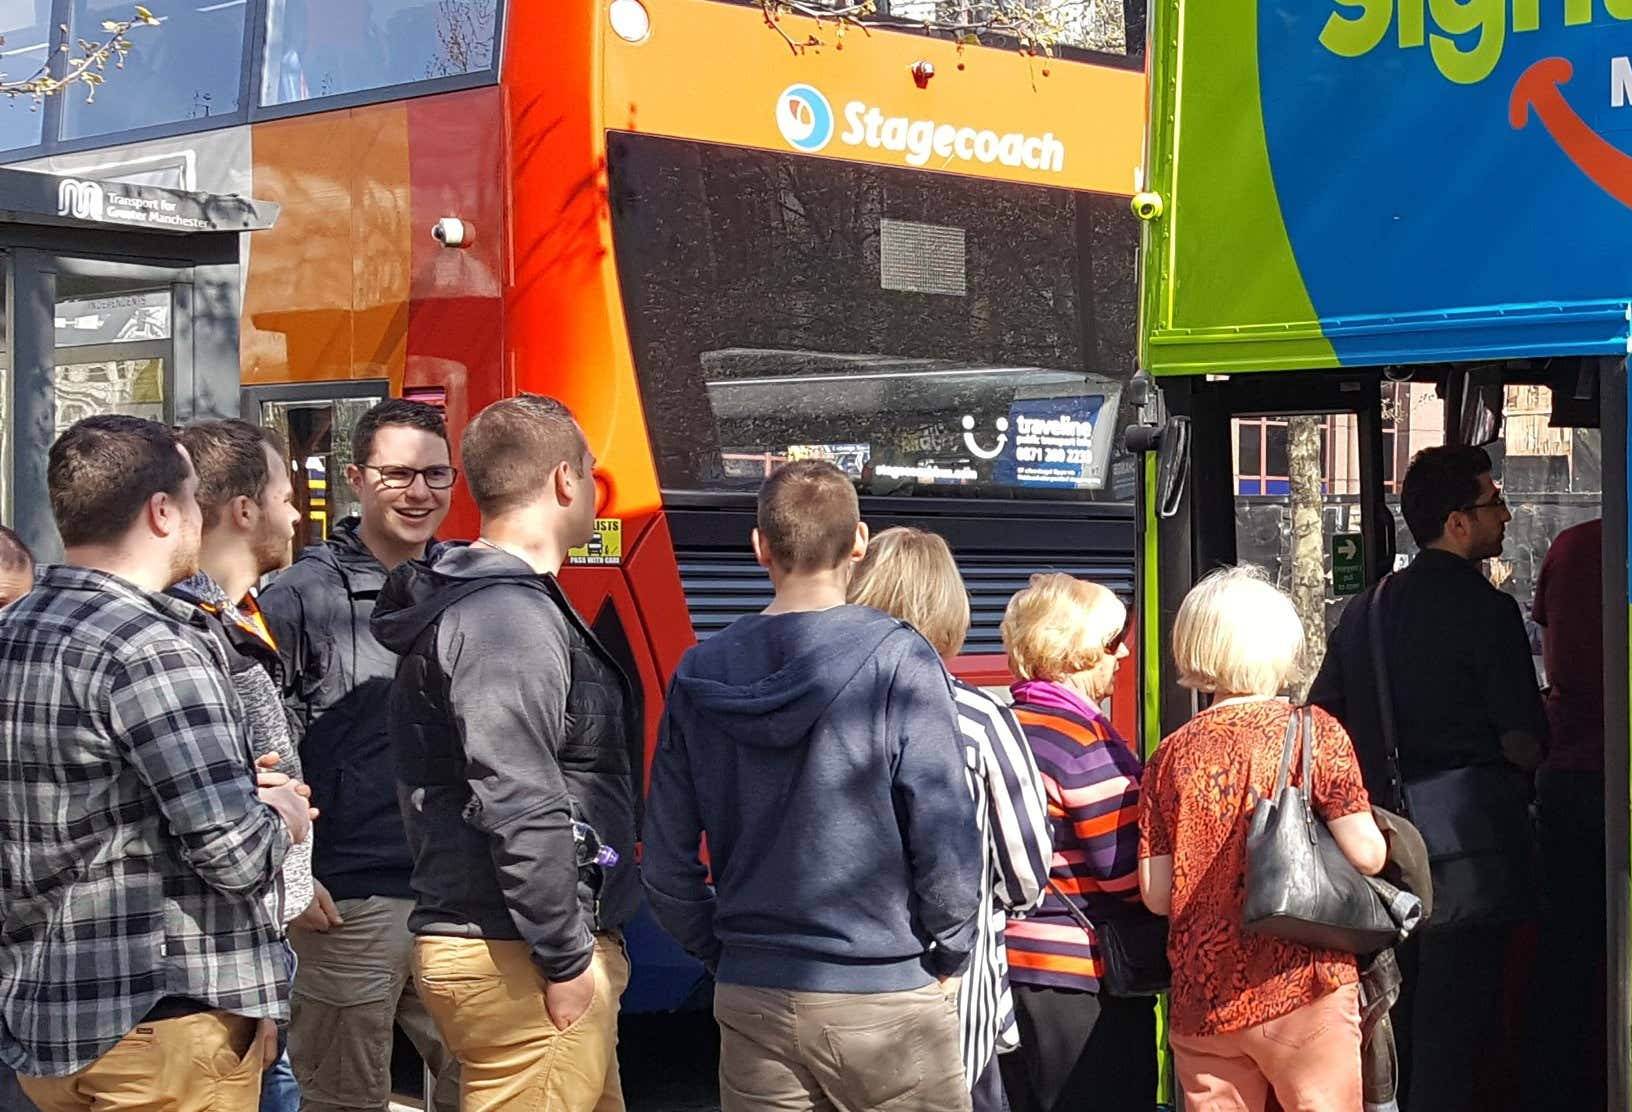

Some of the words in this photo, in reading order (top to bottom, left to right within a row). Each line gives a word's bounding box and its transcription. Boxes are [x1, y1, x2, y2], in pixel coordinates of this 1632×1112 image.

[841, 100, 1064, 172] Stagecoach
[107, 192, 159, 210] Transport
[160, 200, 176, 211] for
[106, 206, 147, 221] Greater
[149, 211, 209, 228] Manchester
[1016, 415, 1092, 438] traveline
